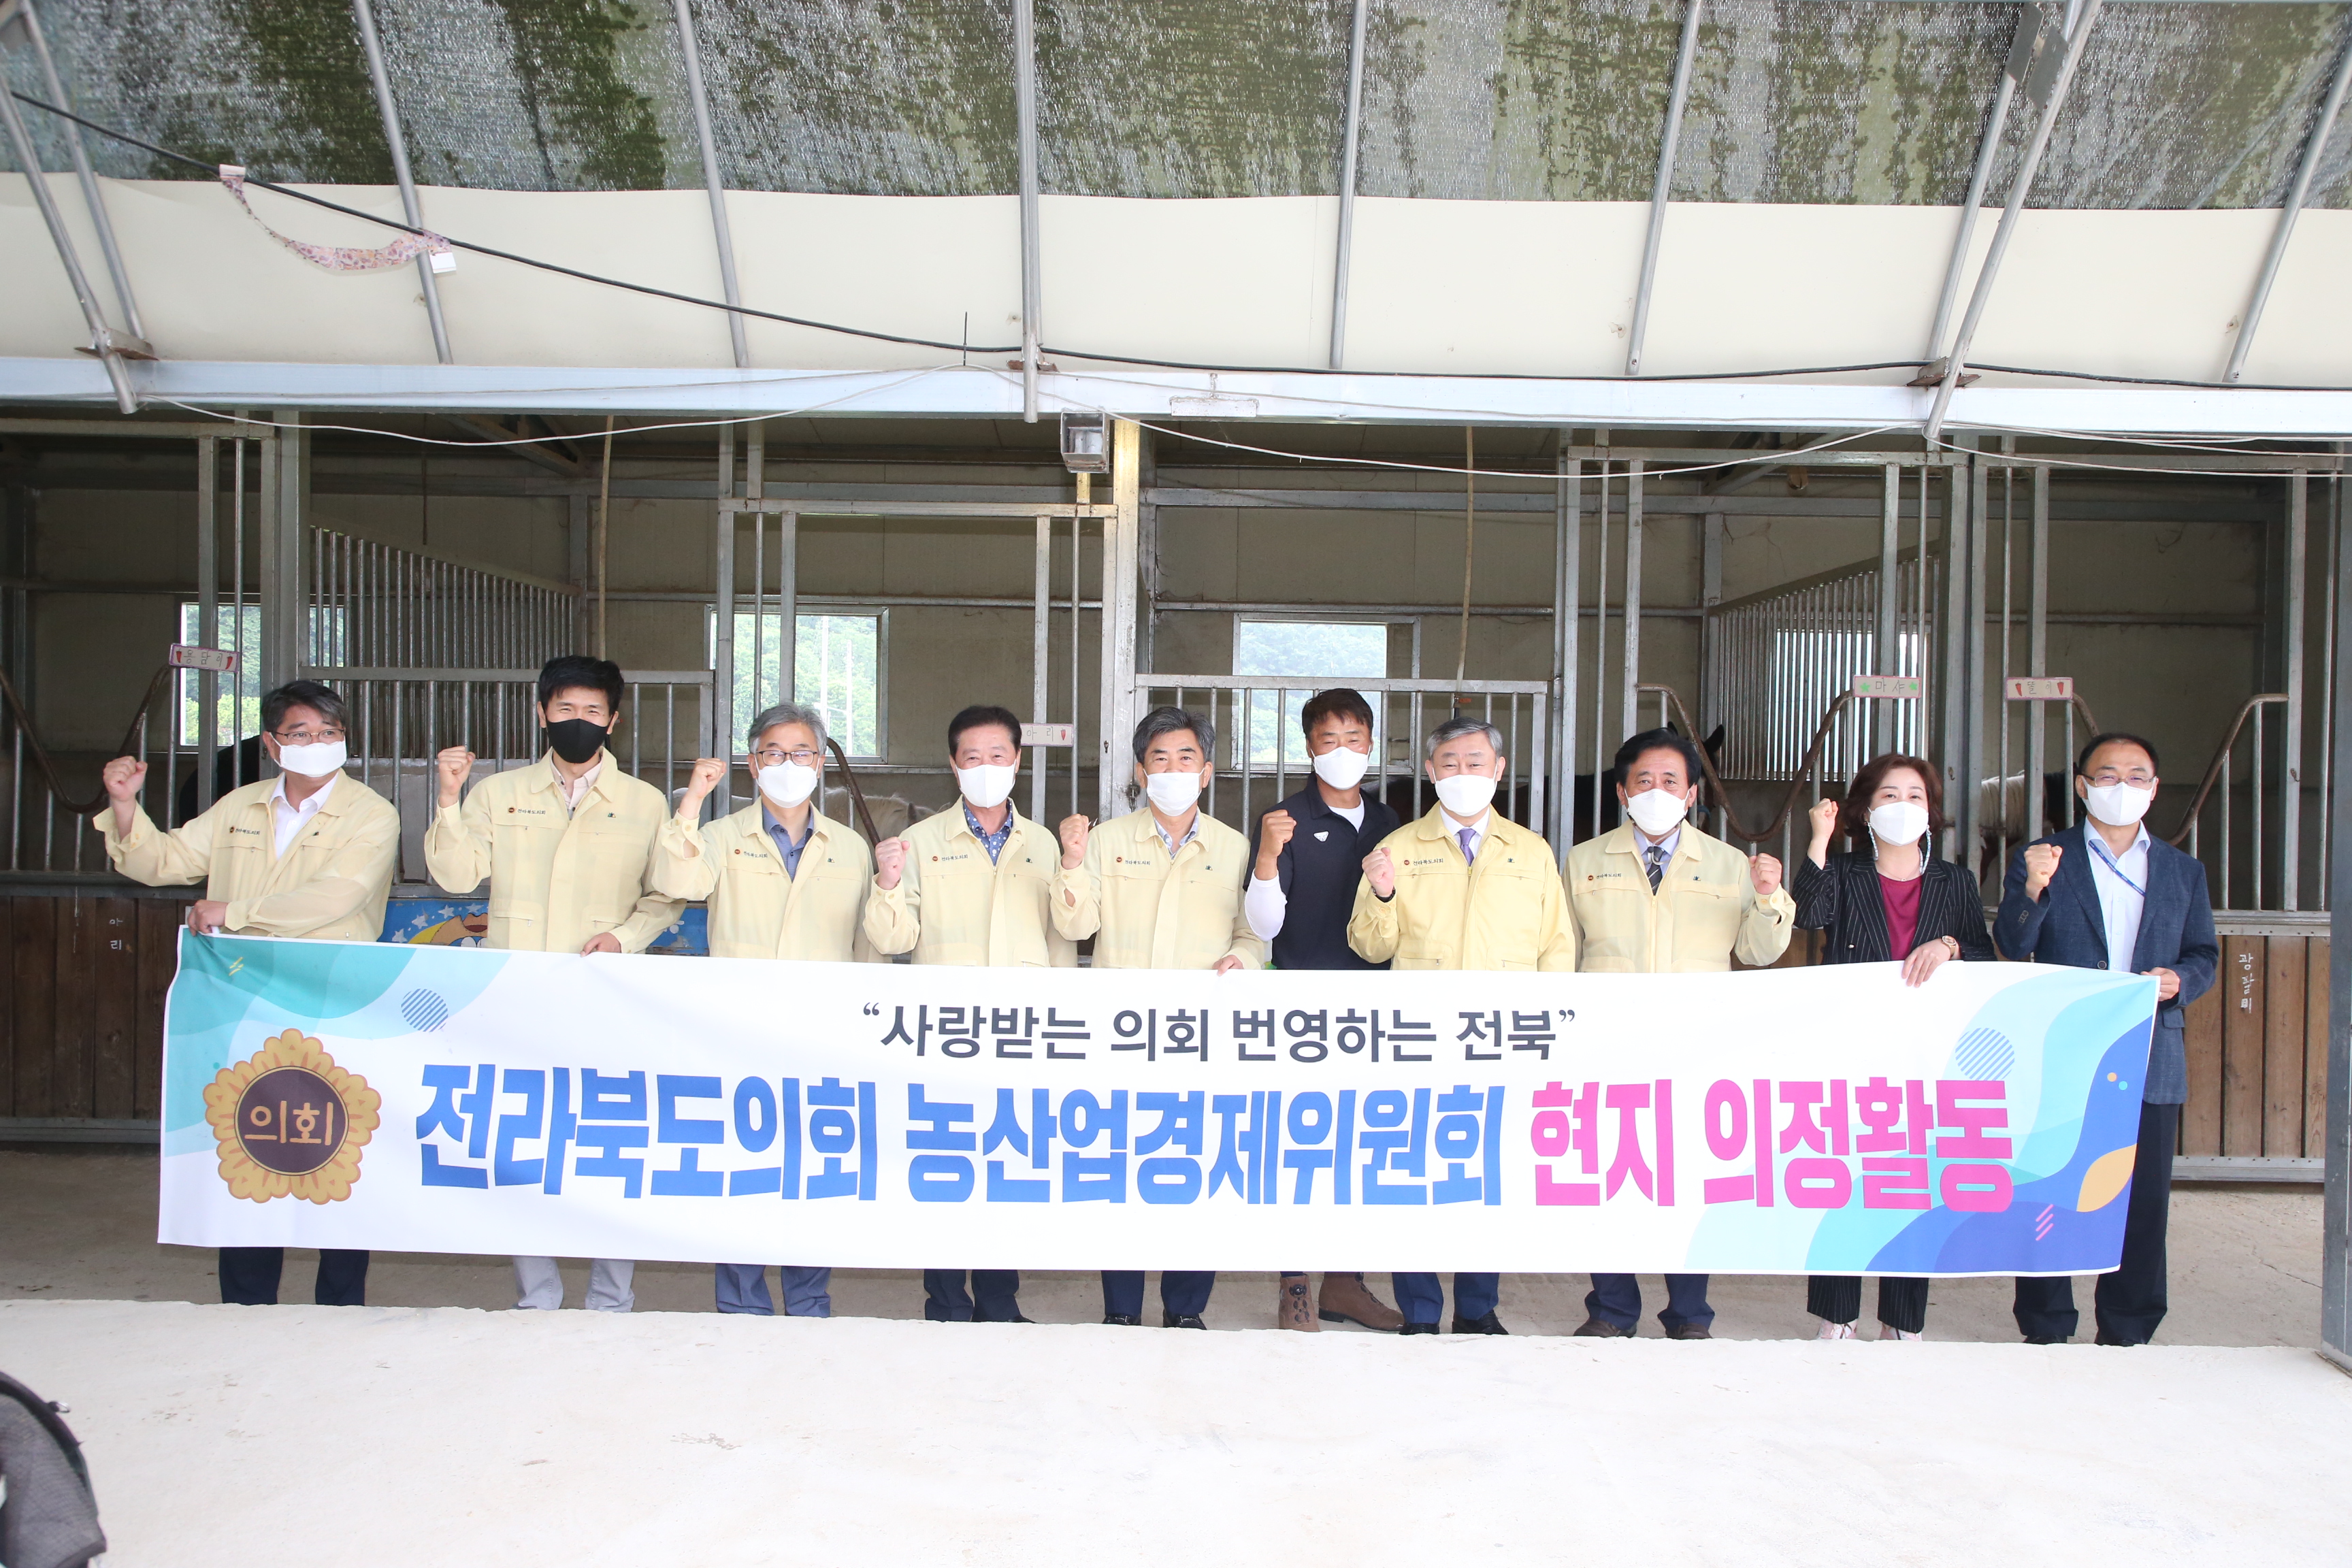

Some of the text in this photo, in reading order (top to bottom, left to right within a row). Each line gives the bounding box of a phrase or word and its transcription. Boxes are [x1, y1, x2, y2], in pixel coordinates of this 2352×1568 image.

[1875, 677, 1905, 694] 마샤
[1111, 1009, 1208, 1062] 의회
[1232, 1009, 1437, 1063] 번영하는
[244, 1100, 333, 1146] 의회
[416, 1064, 2013, 1213] 전라북도의회 농산업경제위원회 현지 의정활동
